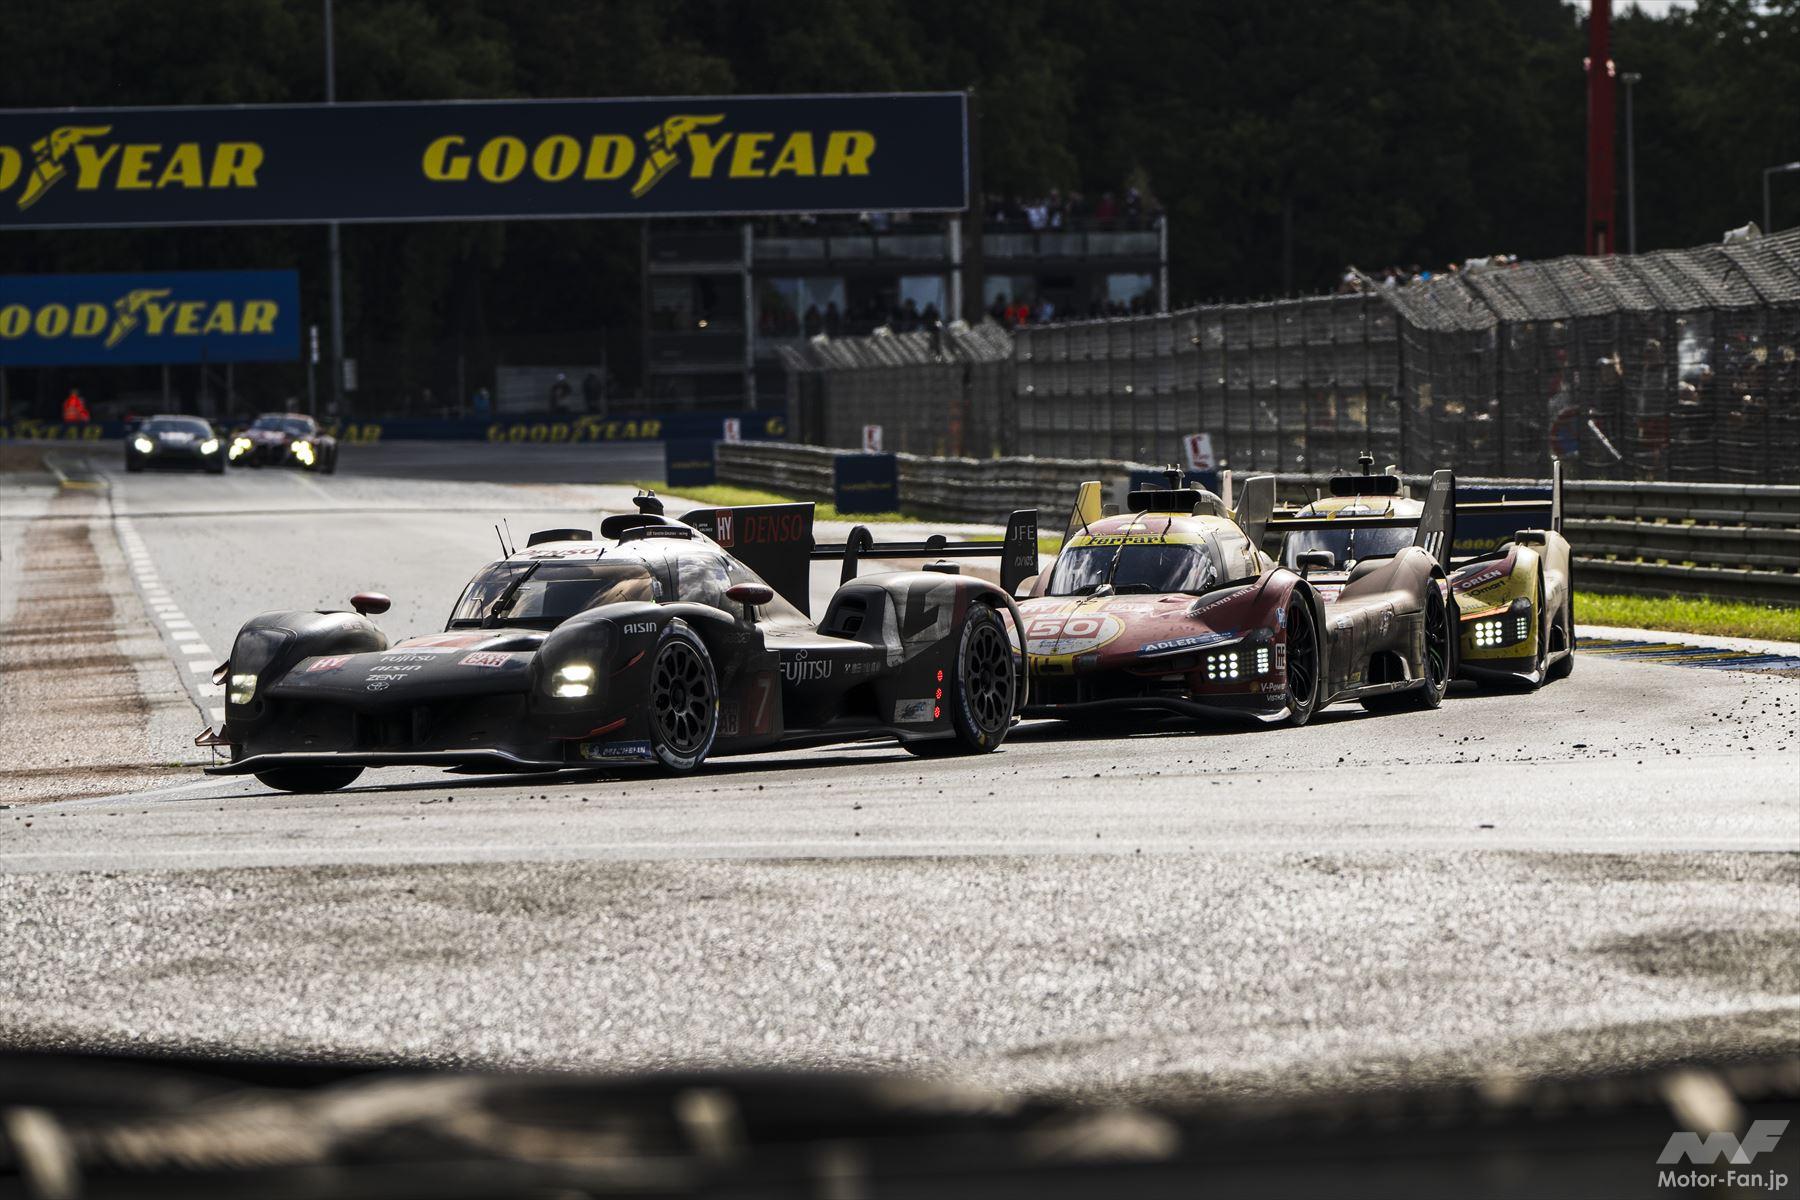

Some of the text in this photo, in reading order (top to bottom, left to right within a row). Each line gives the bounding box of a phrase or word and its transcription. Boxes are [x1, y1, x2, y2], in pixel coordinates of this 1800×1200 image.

[422, 130, 877, 183] GOODYEAR
[487, 420, 662, 441] GOODYEAR
[717, 516, 732, 541] HY
[743, 514, 803, 544] DENSO
[1011, 525, 1035, 541] JFE
[1462, 569, 1502, 588] ORLEN
[623, 622, 658, 635] AISIN
[1029, 619, 1100, 636] 50
[1144, 637, 1197, 652] ADLER
[379, 654, 437, 663] FUJITSU
[365, 673, 409, 681] ZENT
[779, 652, 833, 686] FUJITSU
[754, 678, 772, 727] 7
